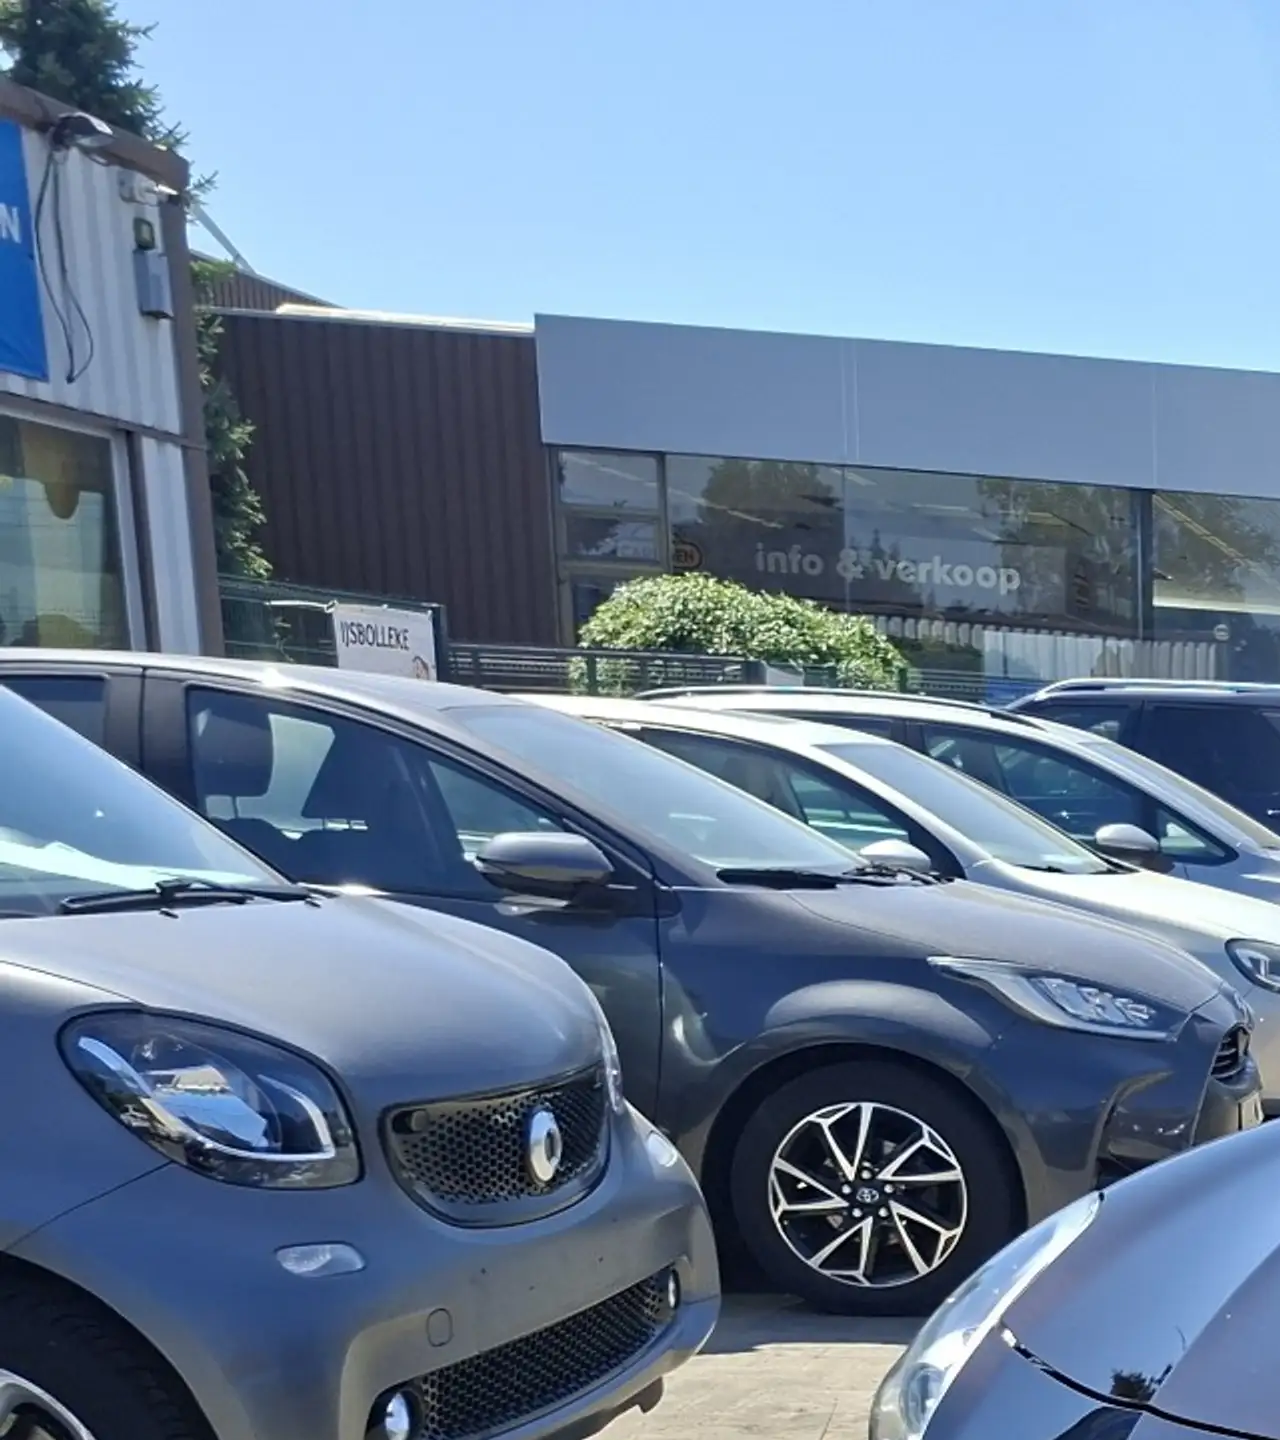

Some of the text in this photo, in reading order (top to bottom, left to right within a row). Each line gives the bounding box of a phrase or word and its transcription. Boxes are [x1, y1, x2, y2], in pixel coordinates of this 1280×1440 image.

[756, 543, 1021, 595] info & verkoop
